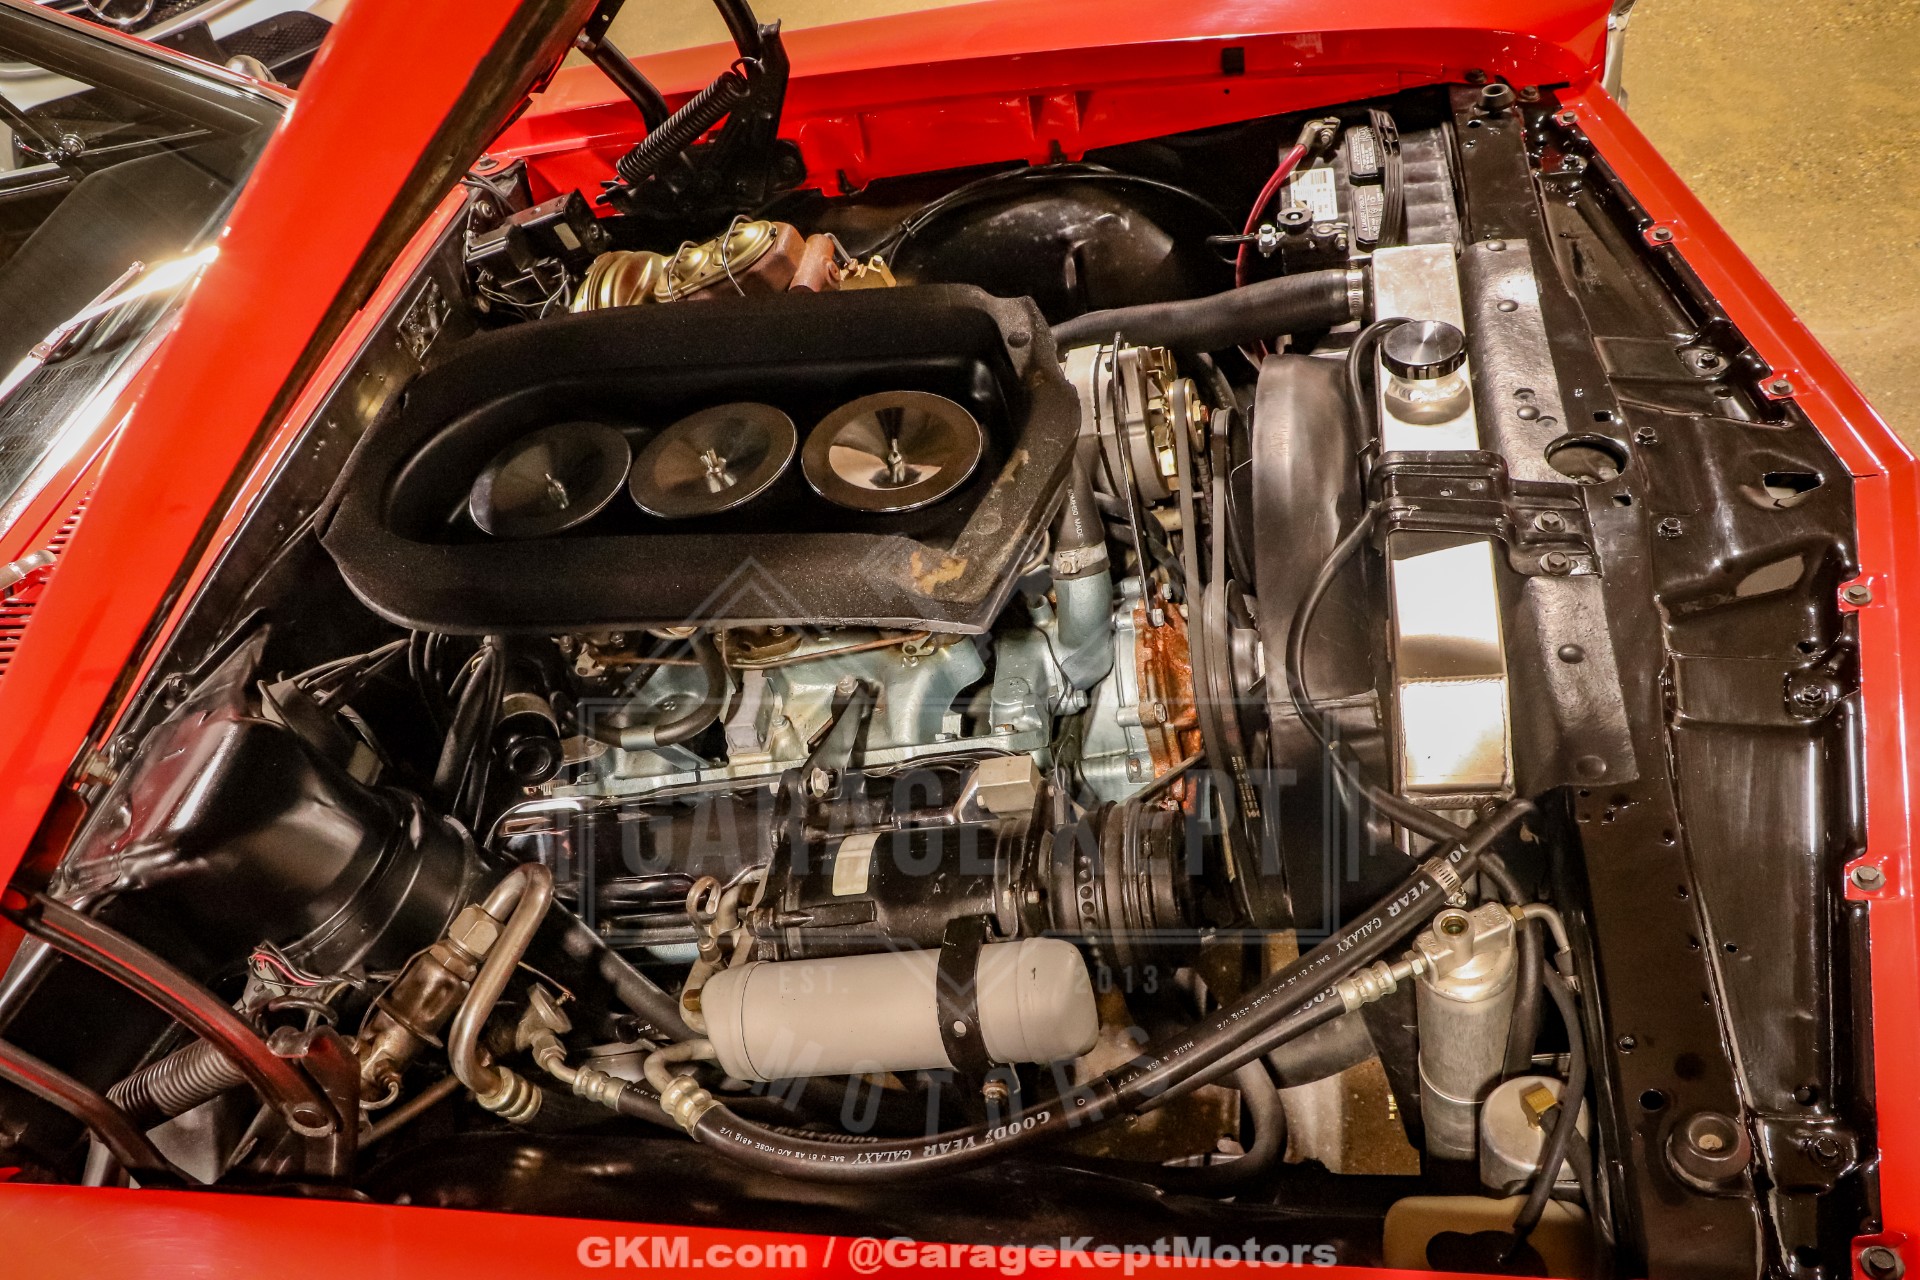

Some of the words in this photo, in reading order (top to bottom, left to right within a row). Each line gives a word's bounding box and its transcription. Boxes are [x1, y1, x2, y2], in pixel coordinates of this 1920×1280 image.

[1074, 518, 1084, 539] MADE
[1387, 880, 1431, 917] YEAR
[1336, 917, 1382, 956] GALAXY
[1252, 993, 1272, 1008] HOSE
[1174, 1040, 1195, 1056] MADE
[1146, 1060, 1161, 1071] USA
[720, 1126, 732, 1137] 1/2
[993, 1111, 1051, 1140] GOOD
[755, 1142, 775, 1153] HOSE
[777, 1148, 792, 1157] A/C
[922, 1135, 977, 1158] YEAR
[829, 1155, 846, 1163] SAE
[851, 1149, 912, 1165] GALAXY
